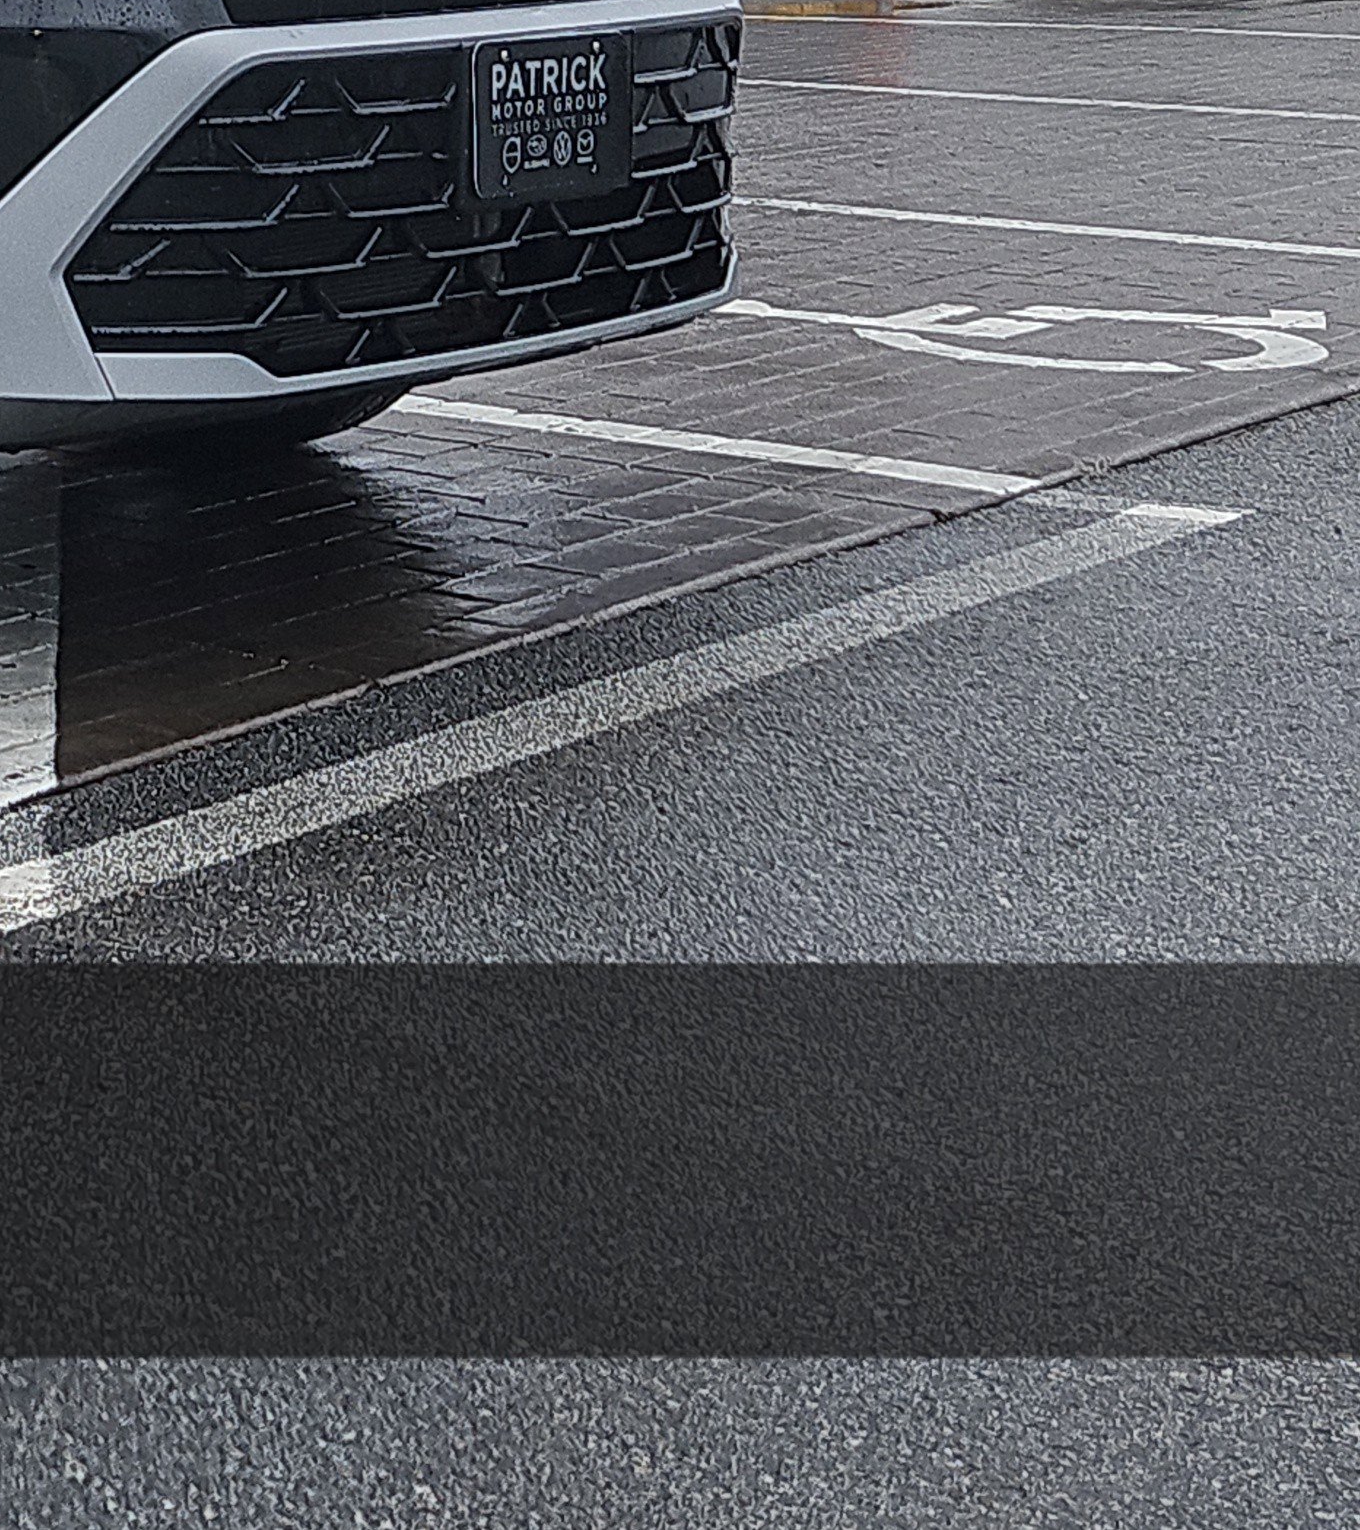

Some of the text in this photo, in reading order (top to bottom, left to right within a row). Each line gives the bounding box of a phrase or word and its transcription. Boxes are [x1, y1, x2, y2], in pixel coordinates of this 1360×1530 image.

[491, 53, 606, 101] PATRICK
[491, 92, 608, 121] MOTOR GROUP
